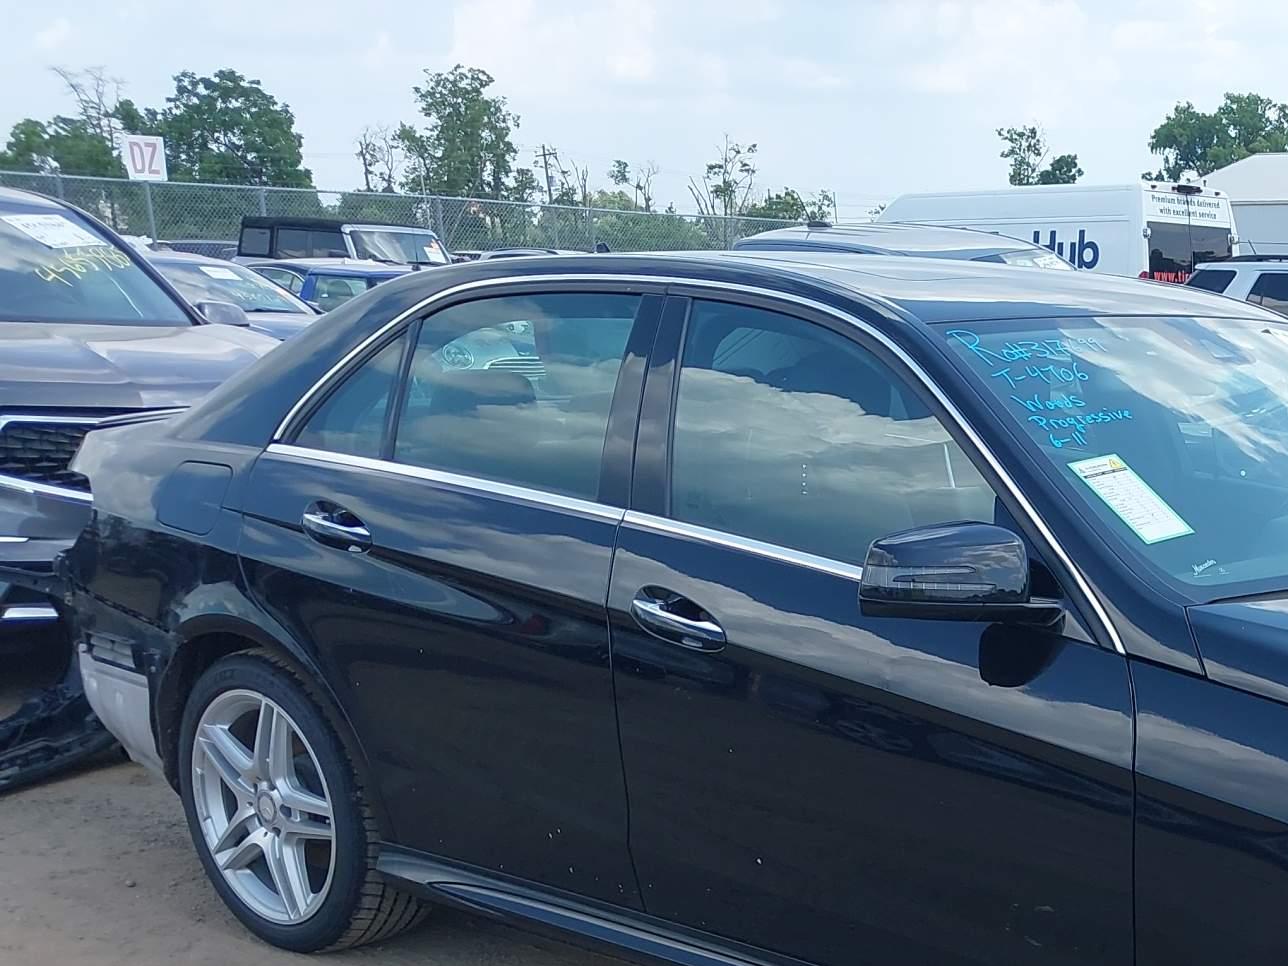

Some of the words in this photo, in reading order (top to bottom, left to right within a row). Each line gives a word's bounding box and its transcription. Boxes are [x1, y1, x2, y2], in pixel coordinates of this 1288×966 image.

[128, 141, 161, 175] DZ
[1151, 194, 1176, 205] Premium
[1159, 206, 1172, 215] with
[1010, 393, 1086, 412] Woods
[1028, 407, 1133, 434] Progressive
